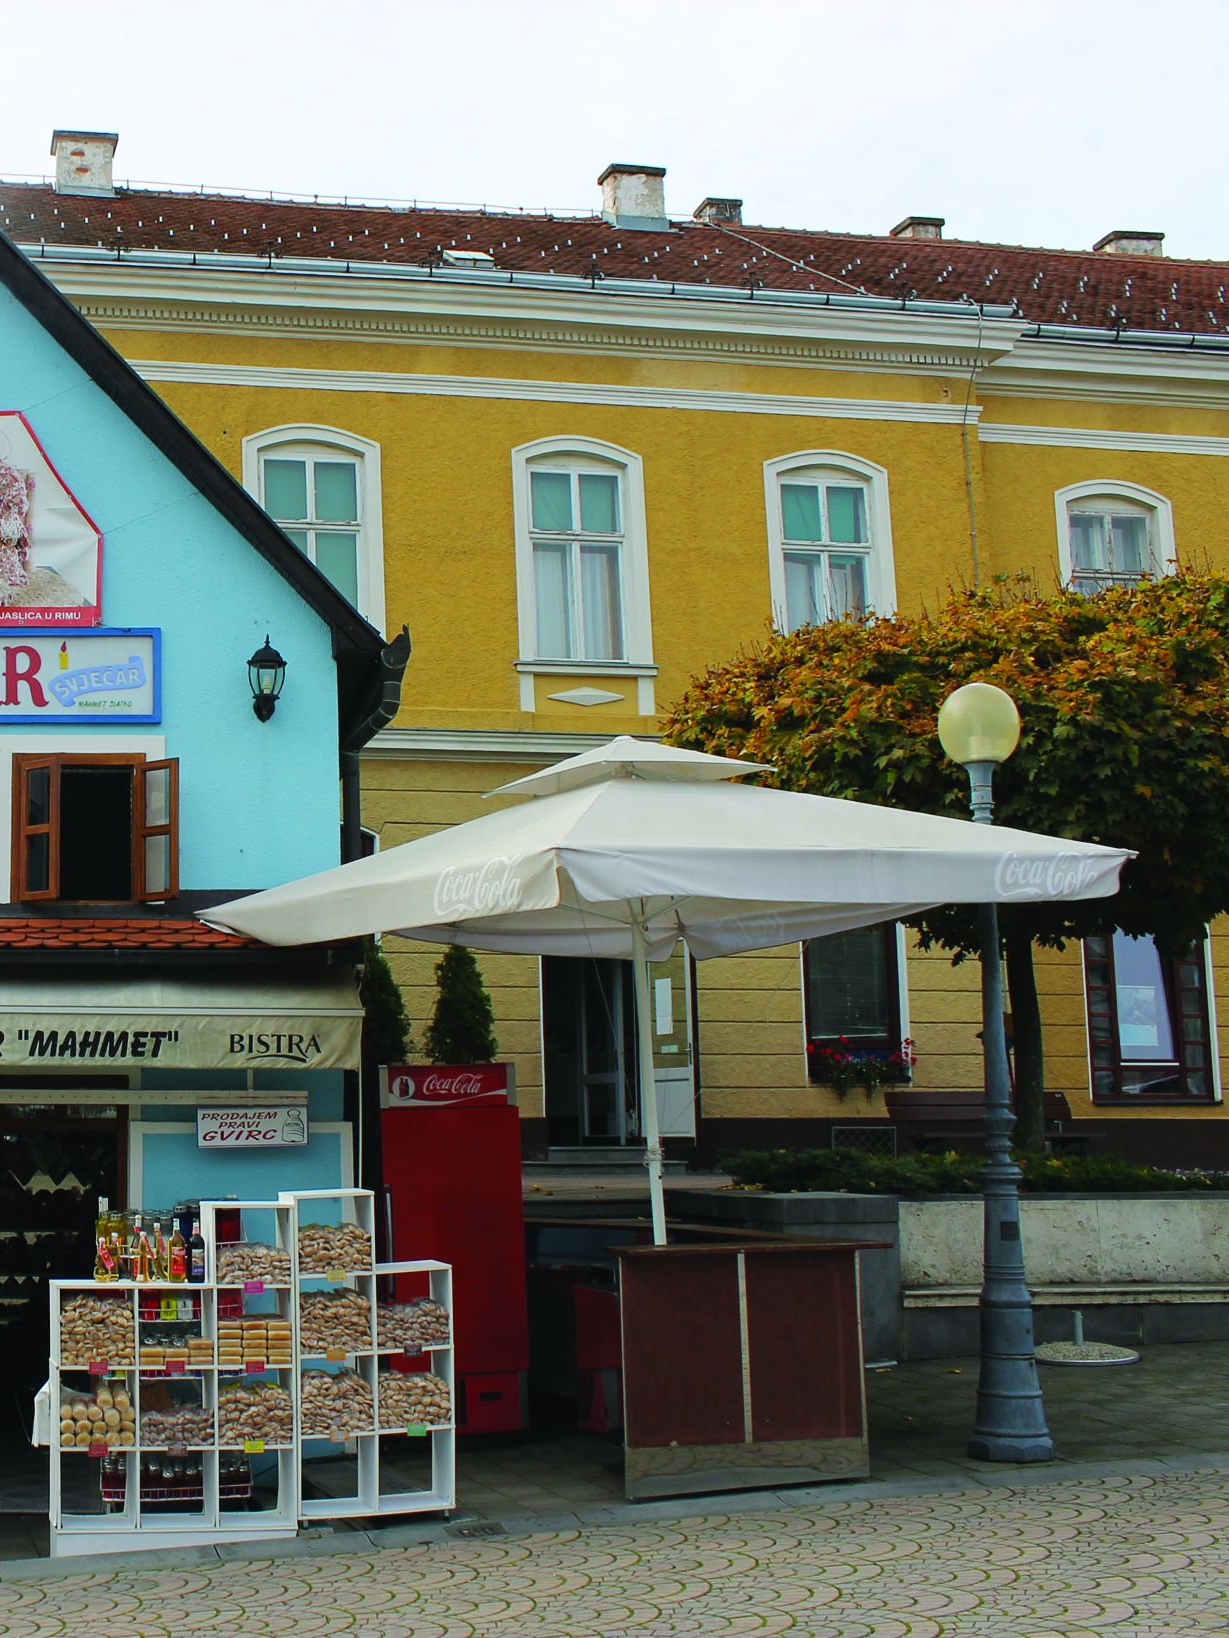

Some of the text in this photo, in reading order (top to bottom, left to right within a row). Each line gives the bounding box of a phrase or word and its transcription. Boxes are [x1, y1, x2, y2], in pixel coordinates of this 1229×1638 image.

[0, 611, 42, 620] JASLICA
[44, 611, 52, 619] U
[54, 611, 81, 620] RIMU
[54, 665, 141, 698] SVJEČAR
[433, 853, 525, 917] Coca-Cola
[994, 850, 1099, 898] Coca-Cola
[17, 1029, 179, 1059] "MAHMET"
[229, 1032, 322, 1060] BISTRA
[422, 1073, 485, 1095] Coca-Cola
[201, 1111, 278, 1121] PRODAJEM
[218, 1121, 261, 1130] PRAVI
[202, 1129, 278, 1142] GVIRC
